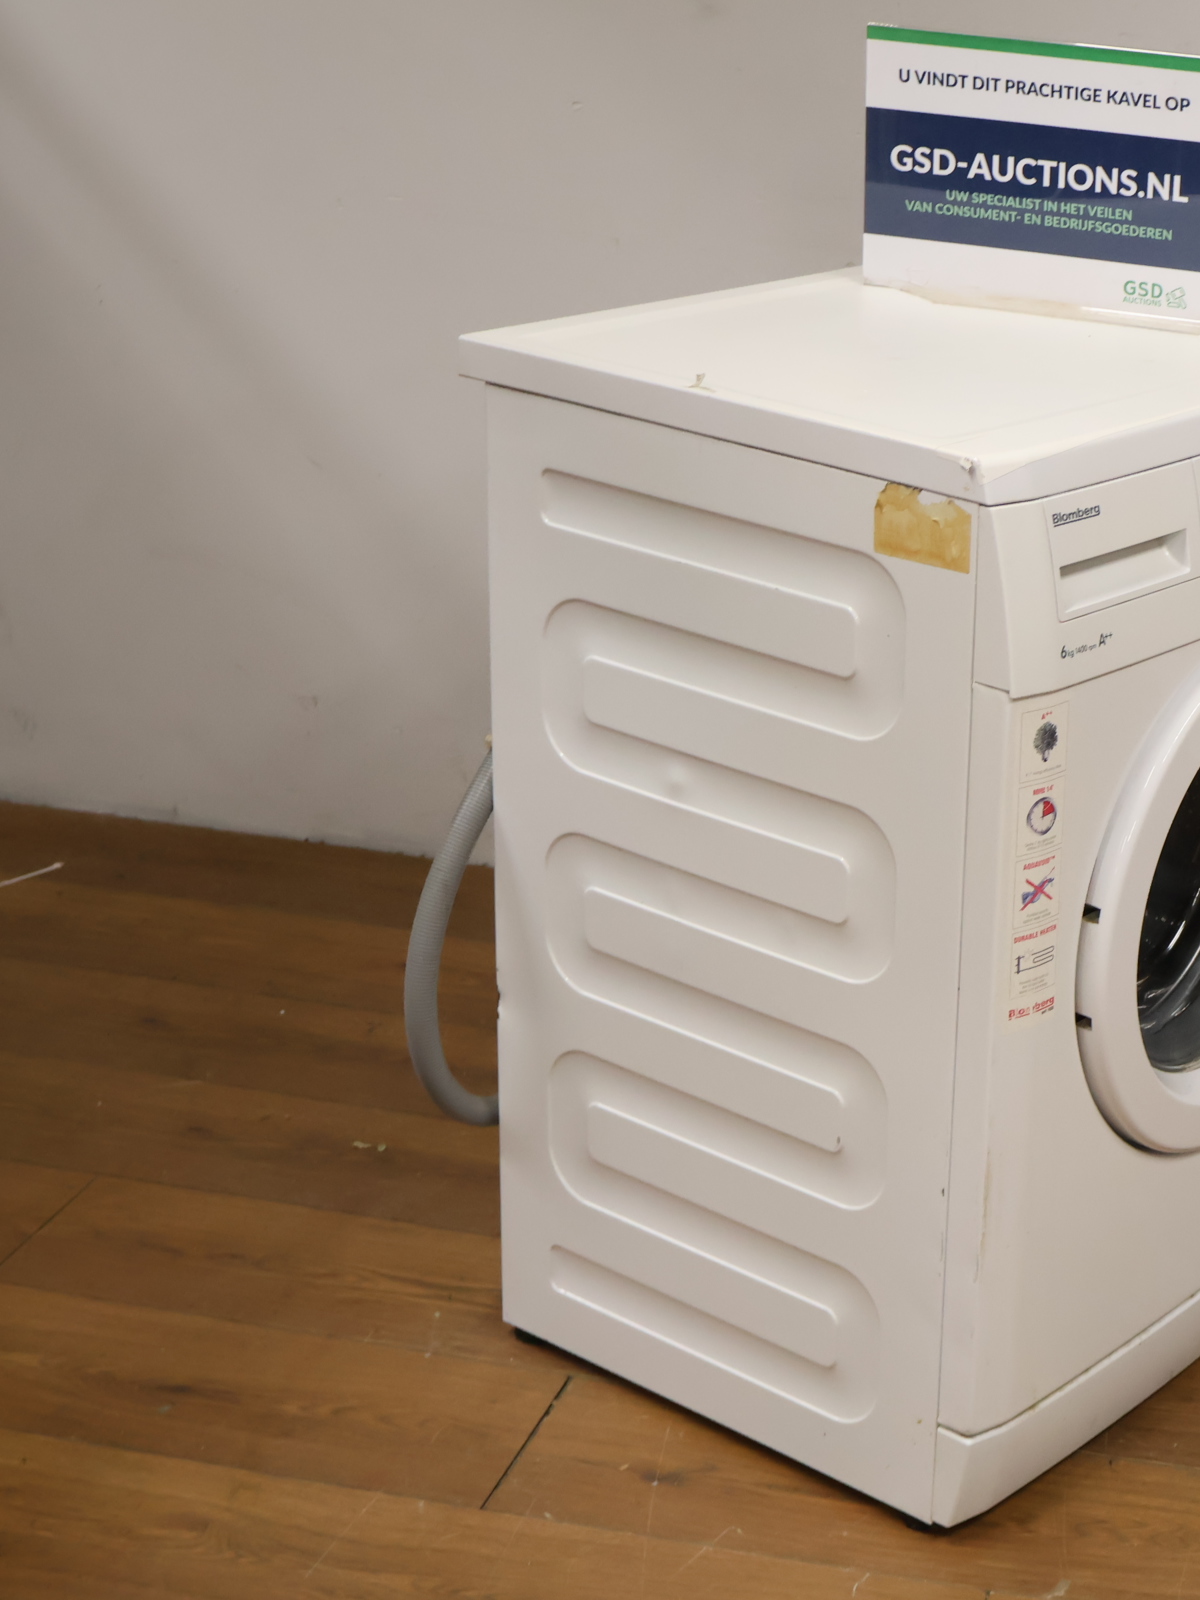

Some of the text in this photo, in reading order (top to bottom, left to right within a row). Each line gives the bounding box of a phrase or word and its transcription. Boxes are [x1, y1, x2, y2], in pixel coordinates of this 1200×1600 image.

[898, 68, 1190, 112] U VINDT DIT PRACHTIGE KAVEL OP
[890, 144, 1189, 203] GSD-AUCTIONS.NL
[905, 199, 1173, 241] VAN CONSUMENT- EN BEDRIJFSGOEDEREN
[945, 189, 1133, 221] UW SPECIALIST IN HET VEILEN
[1123, 280, 1163, 299] GSD
[1123, 296, 1162, 307] AUCTIONS
[1052, 505, 1101, 527] Blomberg
